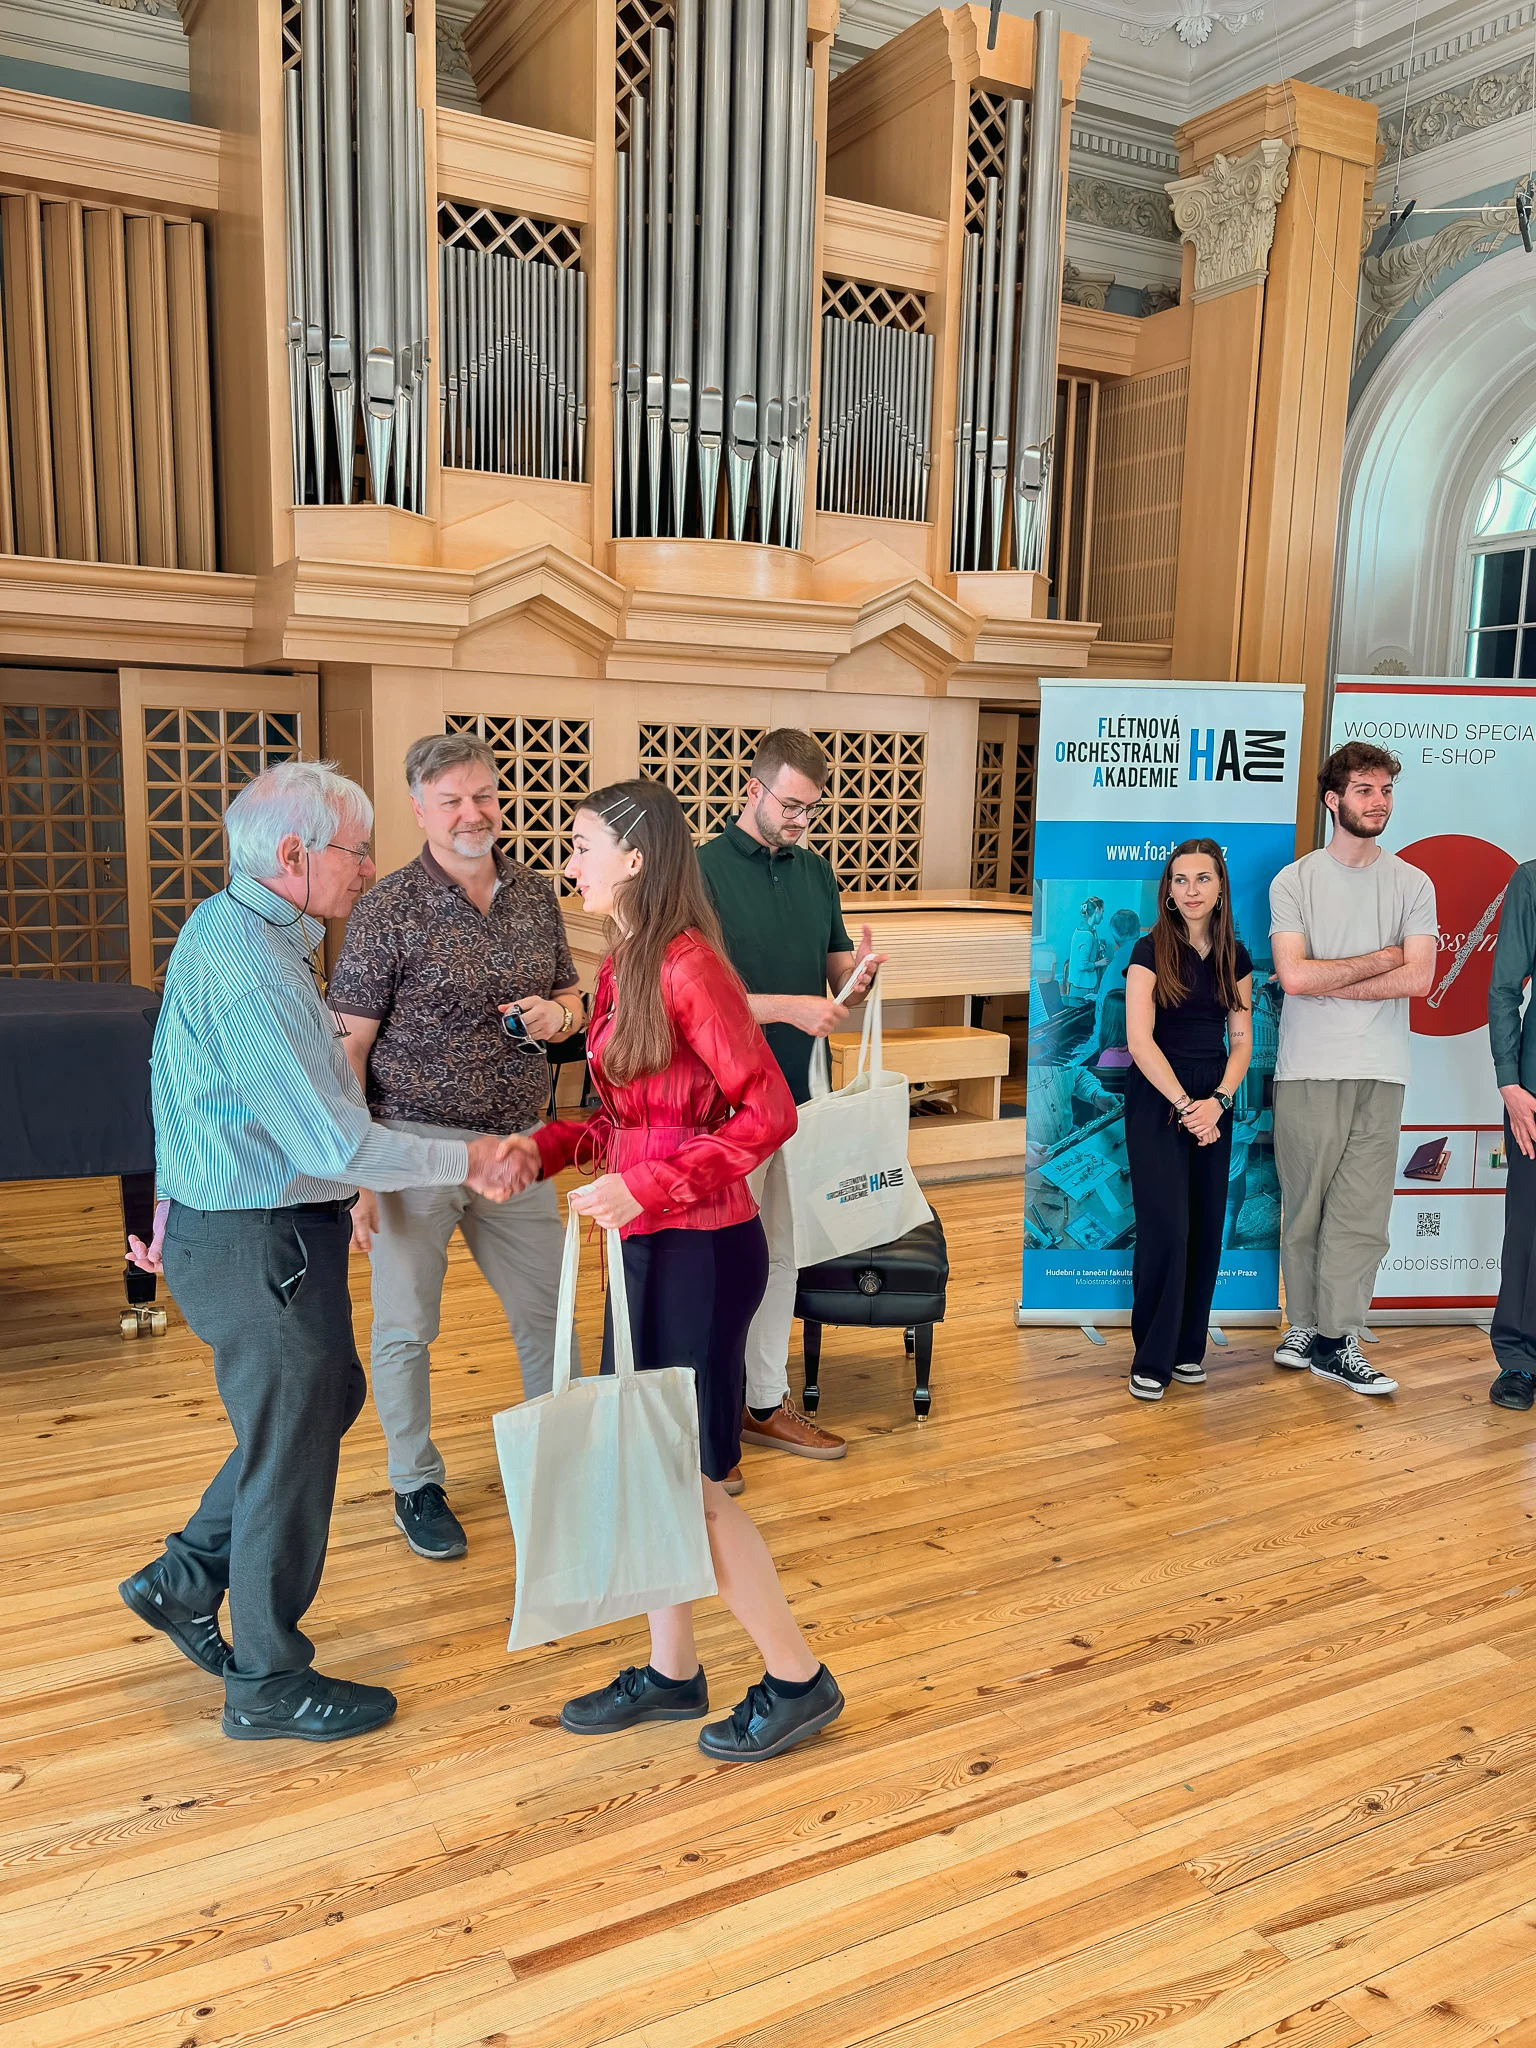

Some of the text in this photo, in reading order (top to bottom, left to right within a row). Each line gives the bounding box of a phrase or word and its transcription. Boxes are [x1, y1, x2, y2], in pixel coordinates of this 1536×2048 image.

[1098, 713, 1180, 739] FLÉTNOVÁ
[1344, 721, 1535, 741] WOODWIND SPECIA
[1055, 738, 1180, 764] ORCHESTRÁLNÍ
[1422, 747, 1497, 765] E-SHOP
[1093, 766, 1179, 788] AKADEMIE
[1045, 1268, 1075, 1276] Hudební
[1082, 1268, 1108, 1277] taneční
[1109, 1268, 1133, 1277] fakulta
[1237, 1268, 1258, 1277] Praze
[1379, 1255, 1502, 1271] .oboissimo.e
